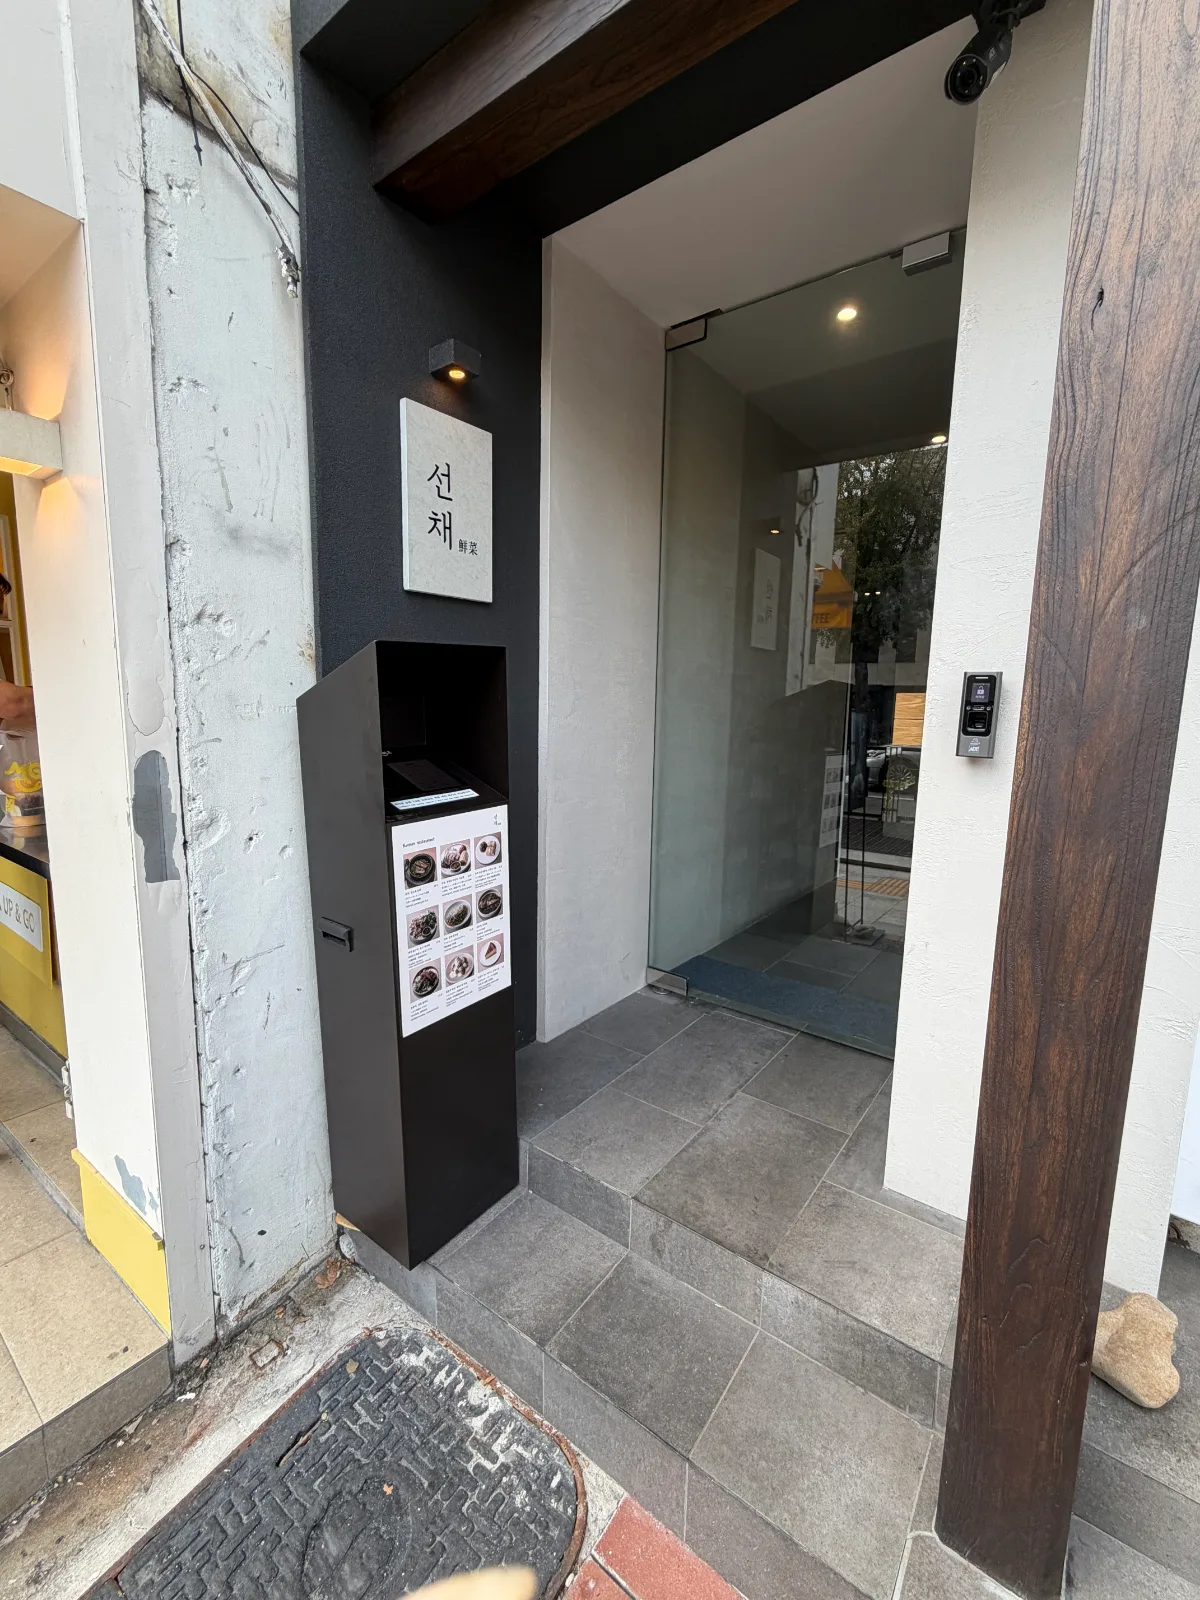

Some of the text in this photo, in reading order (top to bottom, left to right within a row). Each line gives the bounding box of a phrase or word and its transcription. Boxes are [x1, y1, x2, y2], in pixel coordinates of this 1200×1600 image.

[427, 462, 453, 550] 선채
[458, 538, 478, 556] 鮮菜
[3, 895, 35, 933] UP & GO
